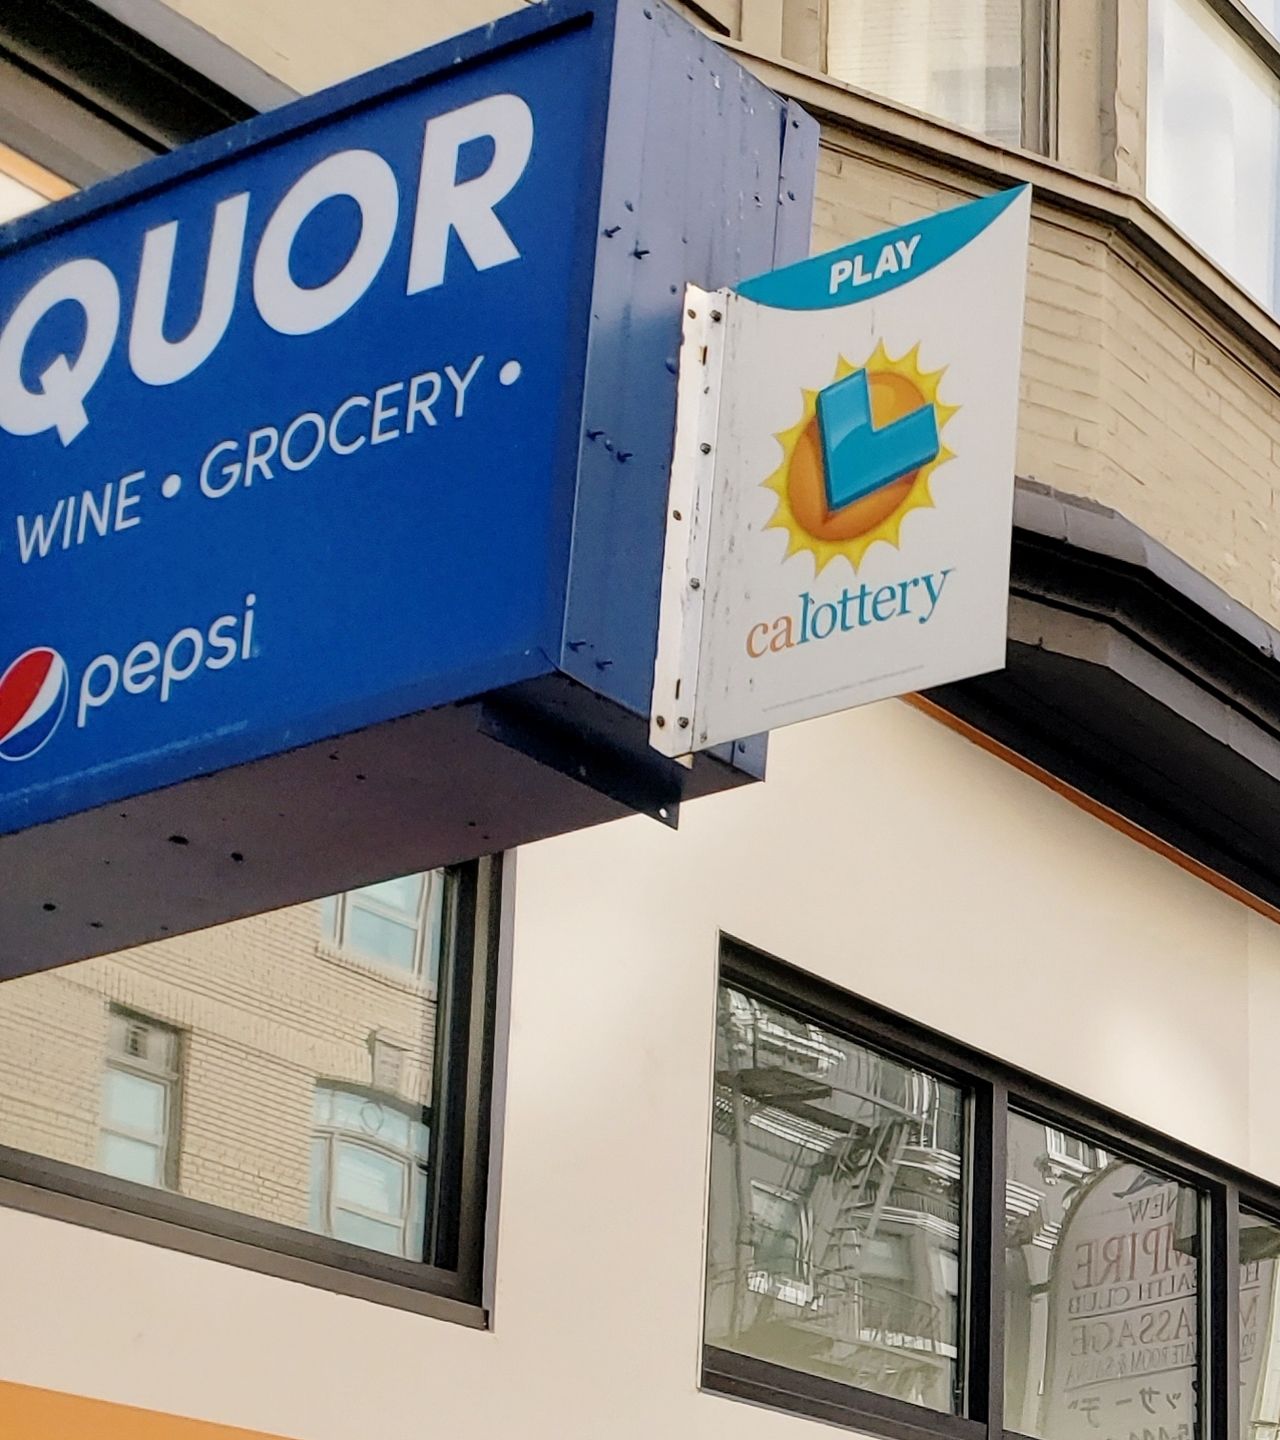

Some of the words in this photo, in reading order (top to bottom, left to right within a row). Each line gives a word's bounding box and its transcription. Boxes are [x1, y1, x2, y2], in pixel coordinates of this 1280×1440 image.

[0, 94, 534, 447] QUOR
[829, 234, 922, 295] PLAY
[15, 470, 147, 564] WINE
[200, 355, 485, 499] GROCERY
[76, 594, 257, 729] pepsi
[745, 567, 953, 659] calottery
